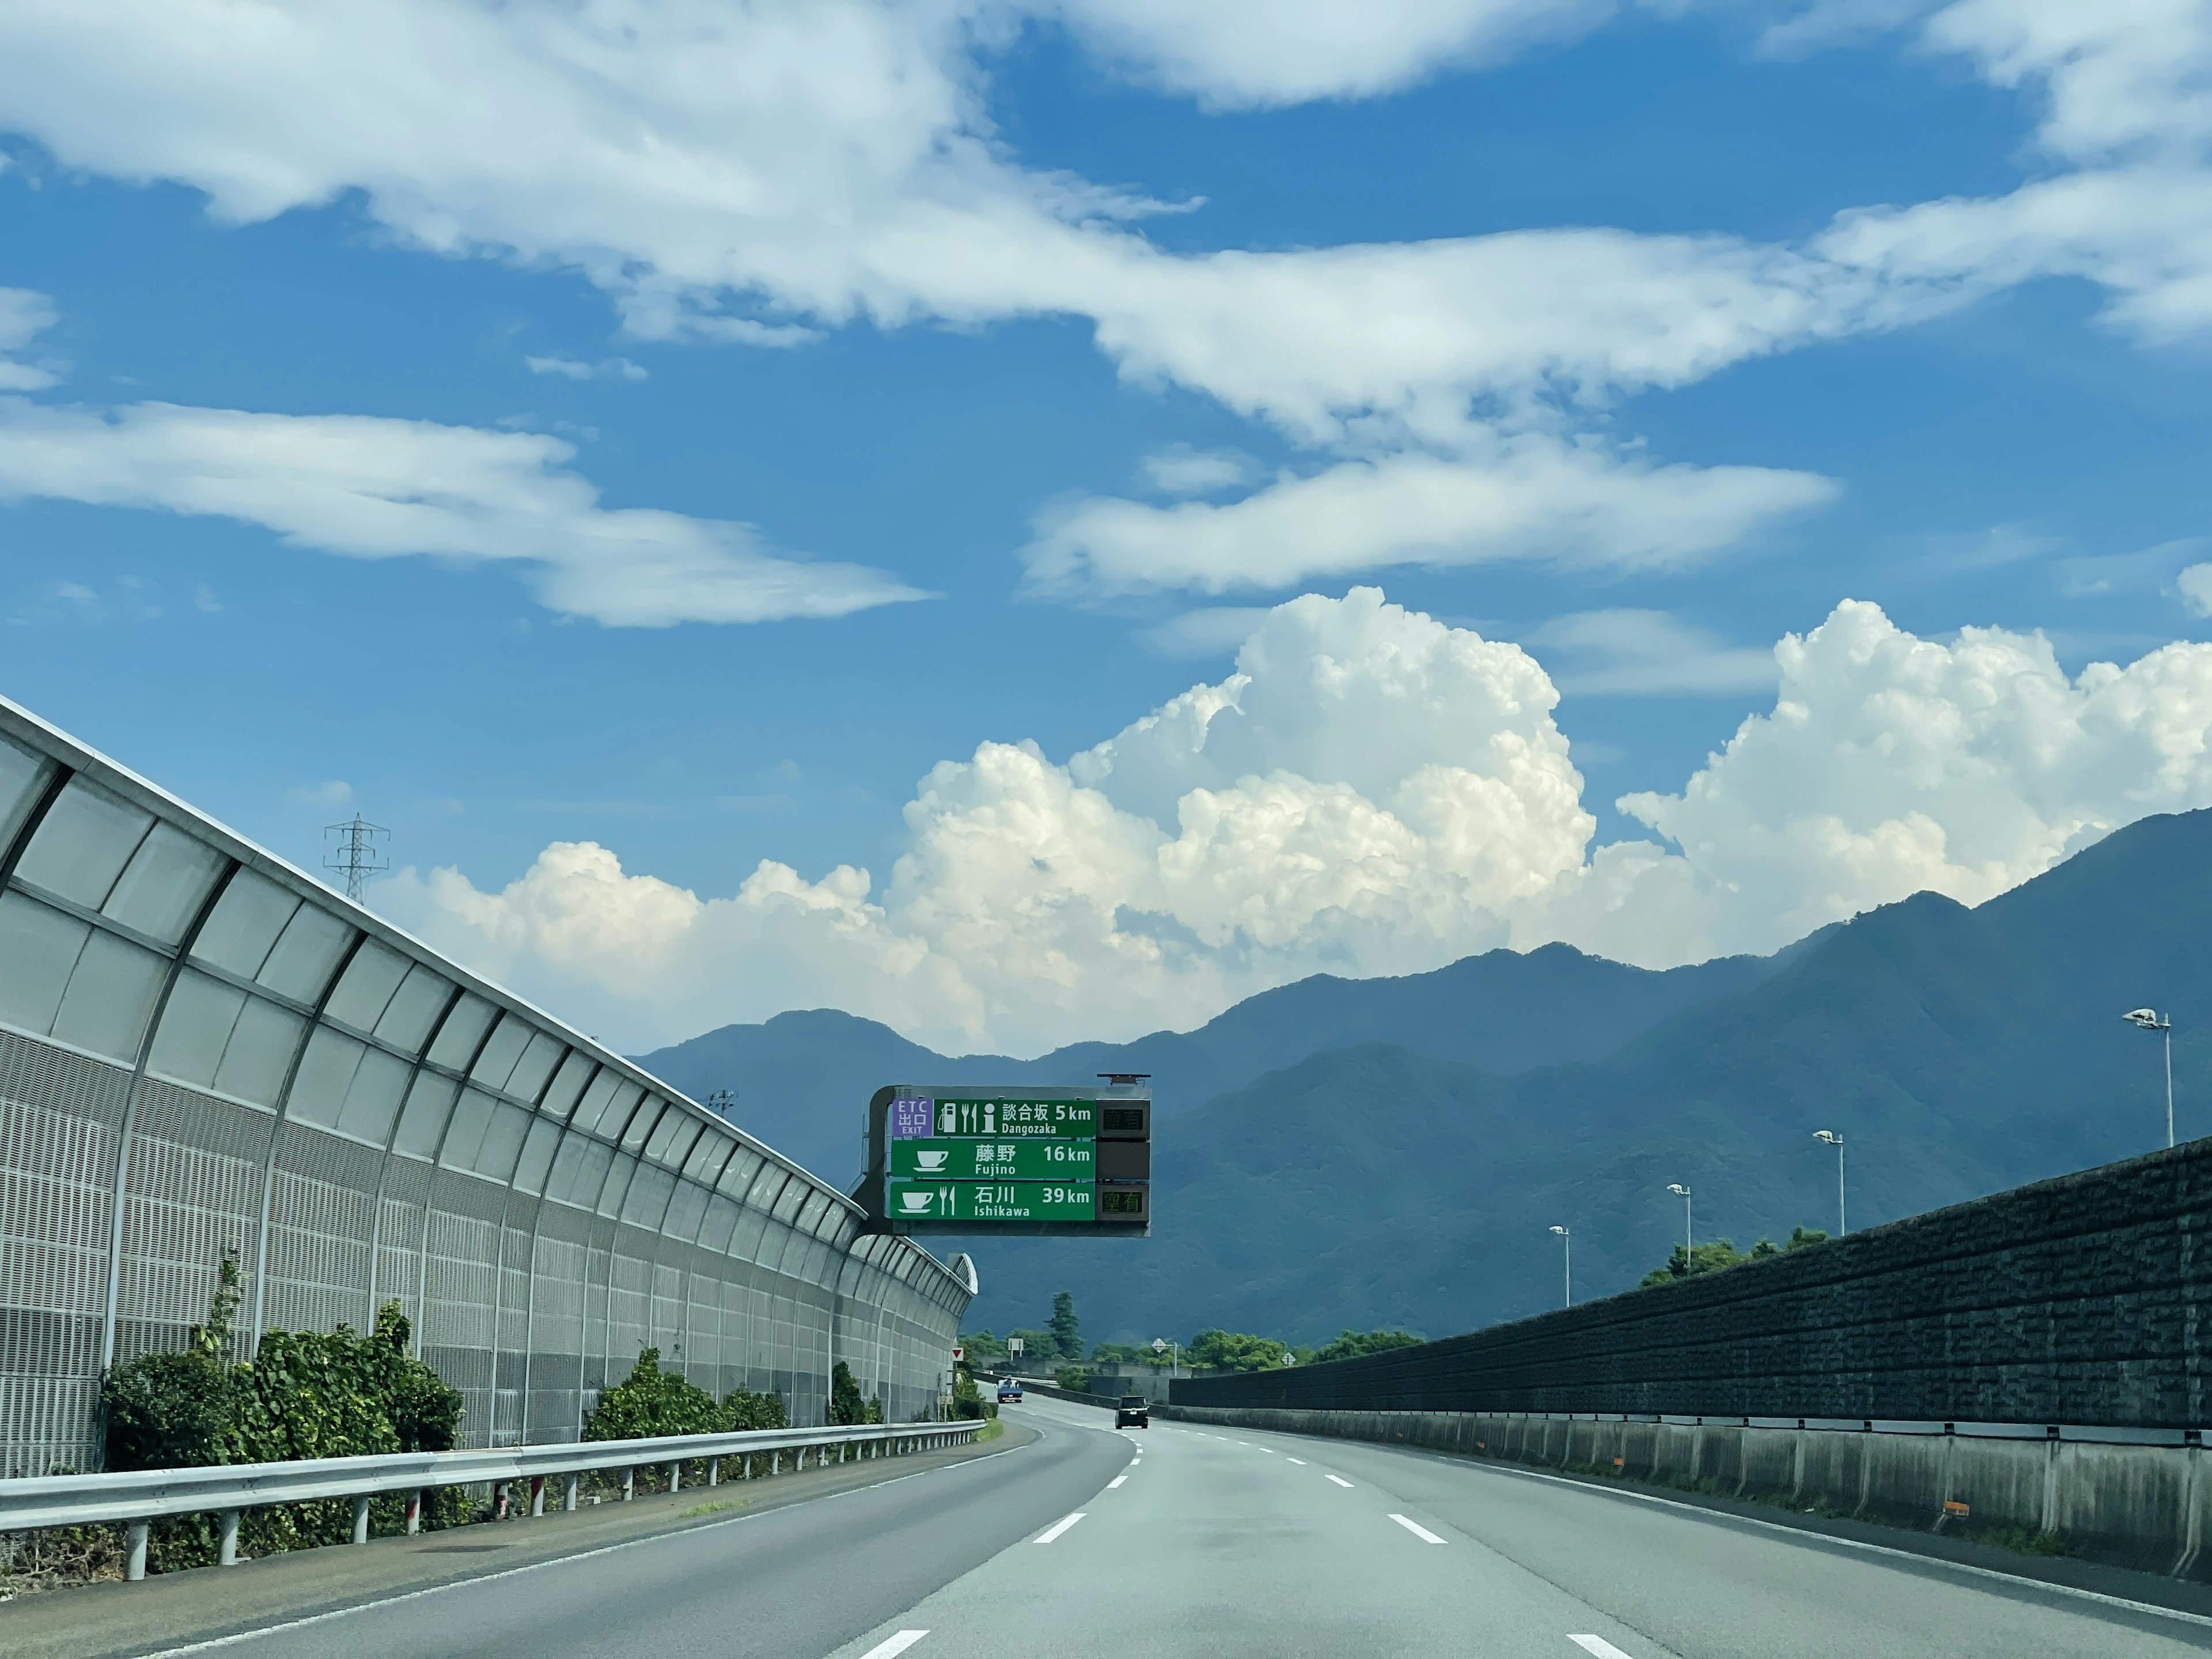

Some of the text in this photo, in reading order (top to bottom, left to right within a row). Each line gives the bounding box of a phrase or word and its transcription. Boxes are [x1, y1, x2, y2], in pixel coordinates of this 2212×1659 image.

[899, 1101, 927, 1112] ETC
[1002, 1103, 1048, 1121] 談合坂
[899, 1113, 926, 1126] 出口
[902, 1126, 922, 1134] EXIT
[1002, 1123, 1056, 1136] Dangozaka
[976, 1144, 1016, 1162] 藤野
[975, 1164, 1016, 1177] Fujino
[975, 1186, 1014, 1204] 石川
[974, 1205, 1030, 1217] Ishikawa
